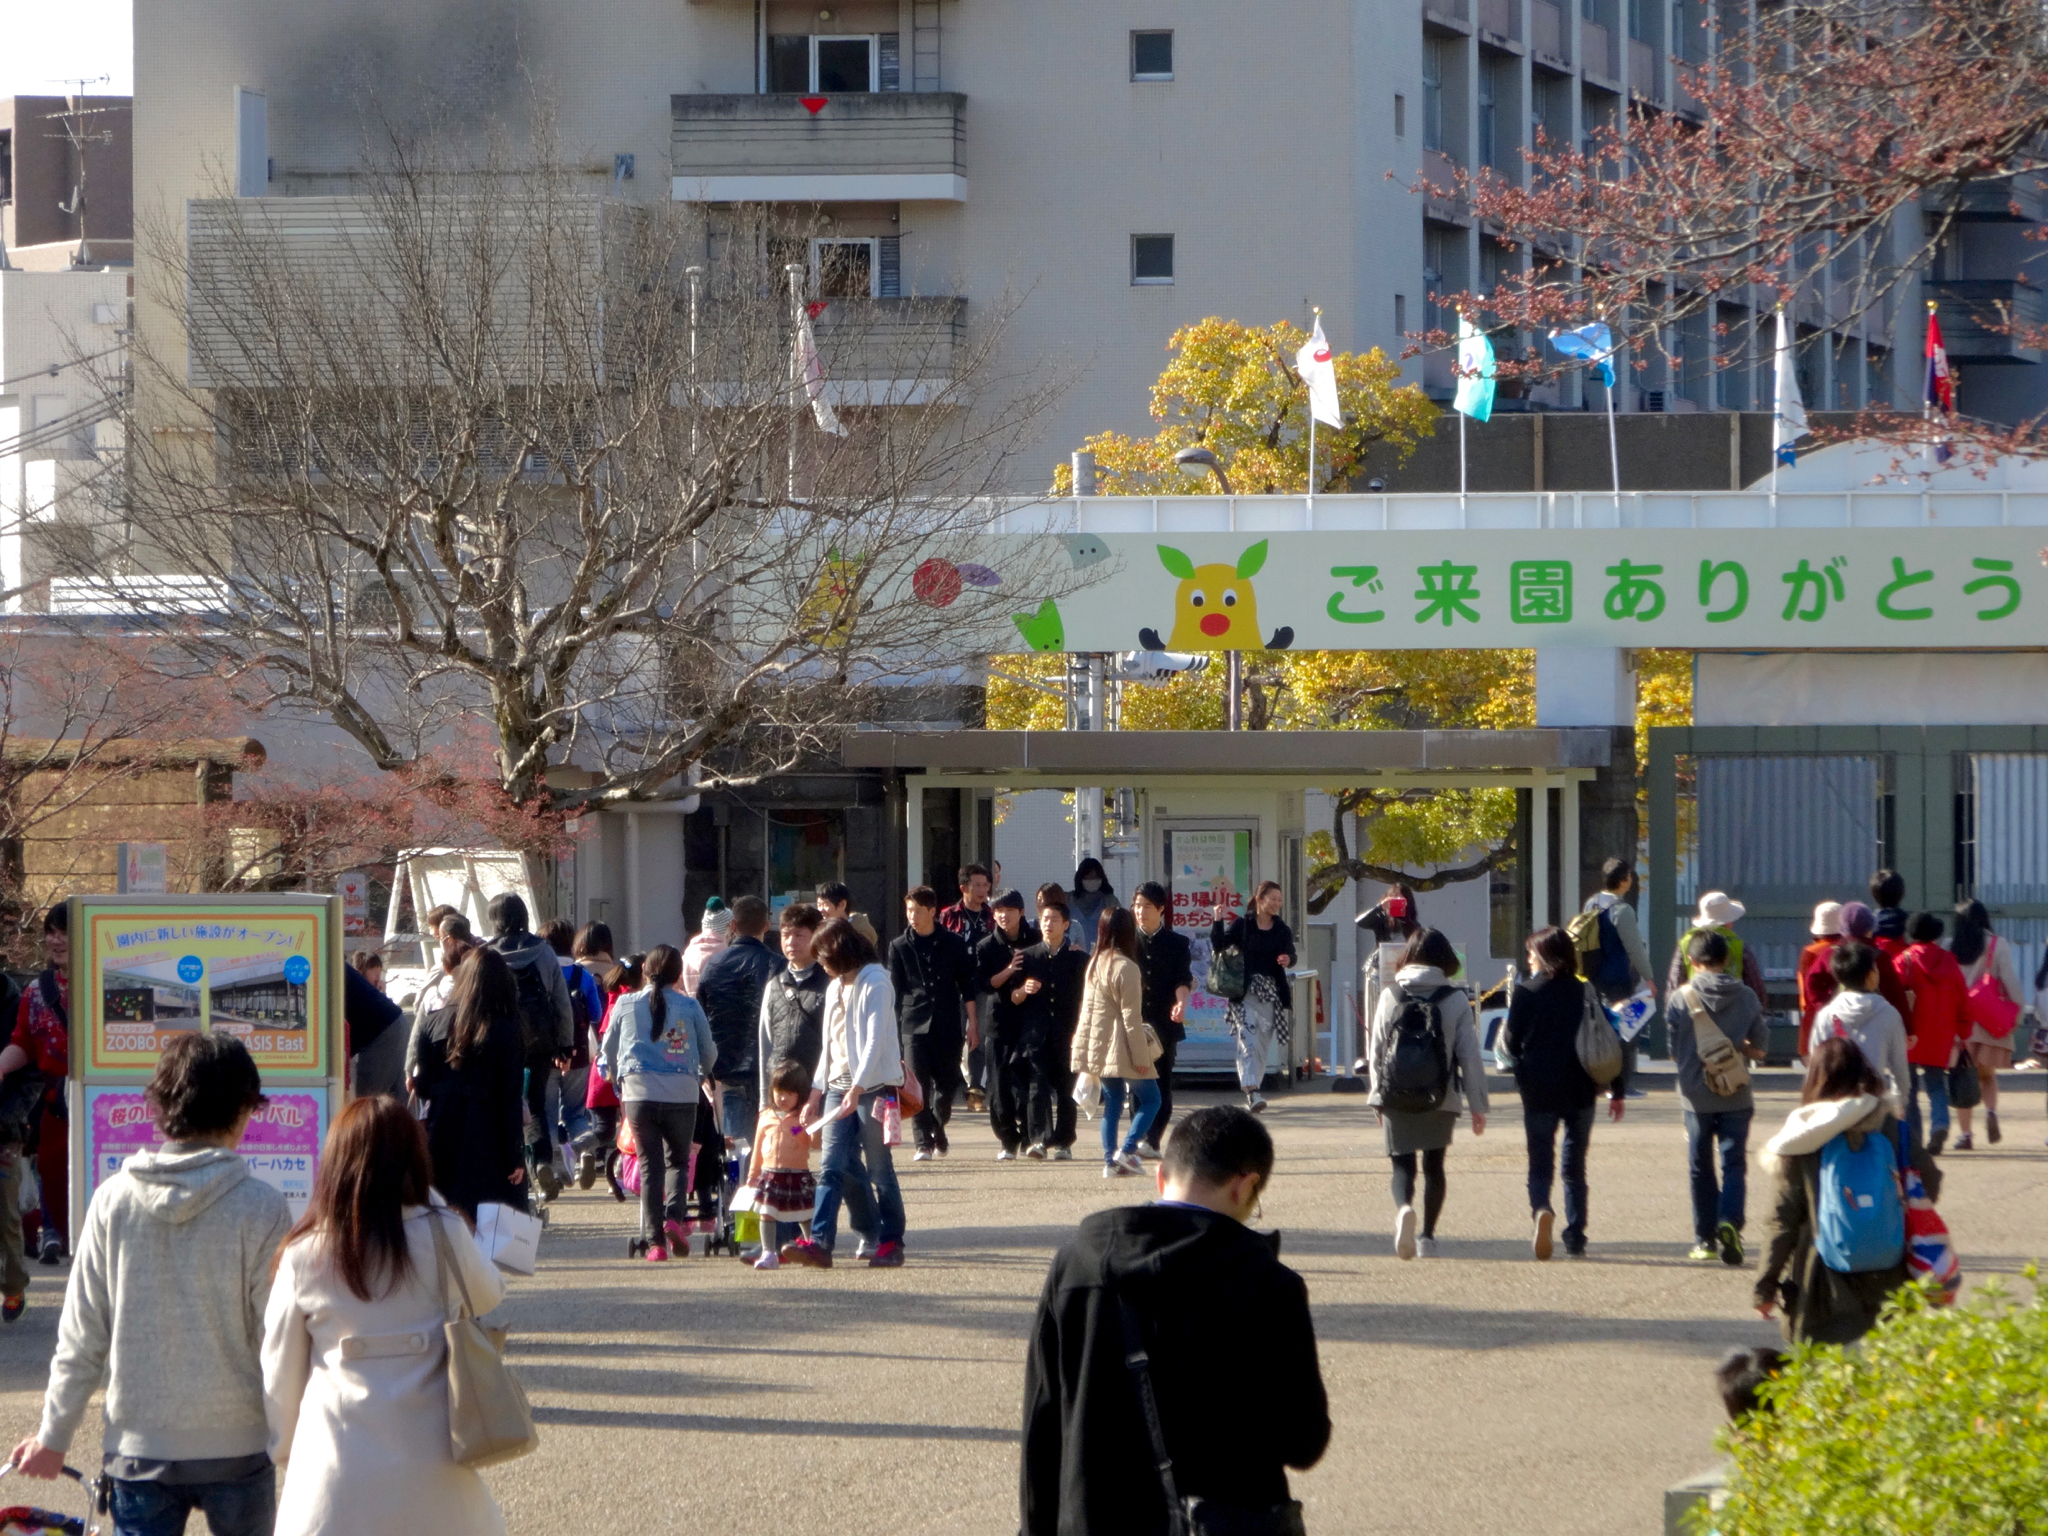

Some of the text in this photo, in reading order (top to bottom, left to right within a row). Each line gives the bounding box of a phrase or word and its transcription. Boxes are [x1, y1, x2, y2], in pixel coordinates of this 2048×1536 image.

[1326, 557, 2022, 626] ご来園ありがとう
[1173, 891, 1243, 908] お帰りは
[1173, 911, 1214, 928] あちら
[106, 1035, 157, 1051] ZOOBO
[277, 1035, 304, 1051] East
